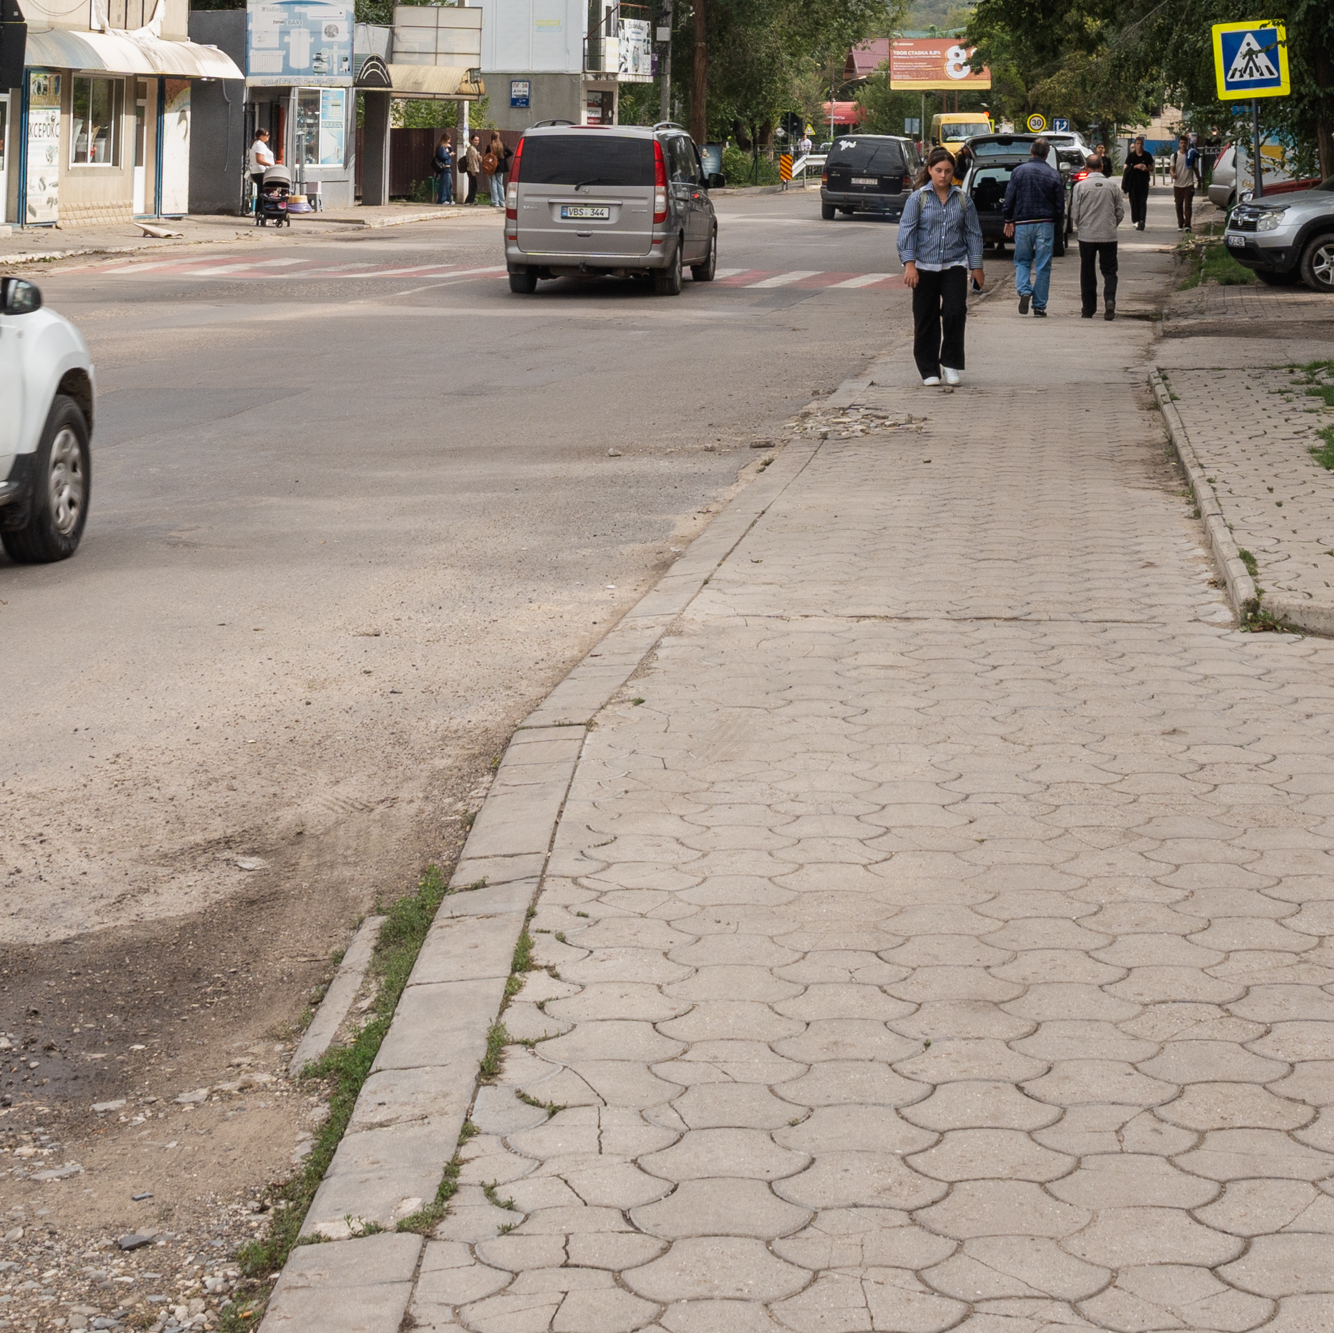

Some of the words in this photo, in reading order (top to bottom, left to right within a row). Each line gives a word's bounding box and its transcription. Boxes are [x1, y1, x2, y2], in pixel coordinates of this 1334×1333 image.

[1031, 119, 1042, 127] 30
[28, 122, 60, 138] КСЕРОКС
[568, 208, 584, 216] VBS
[589, 208, 605, 217] 344
